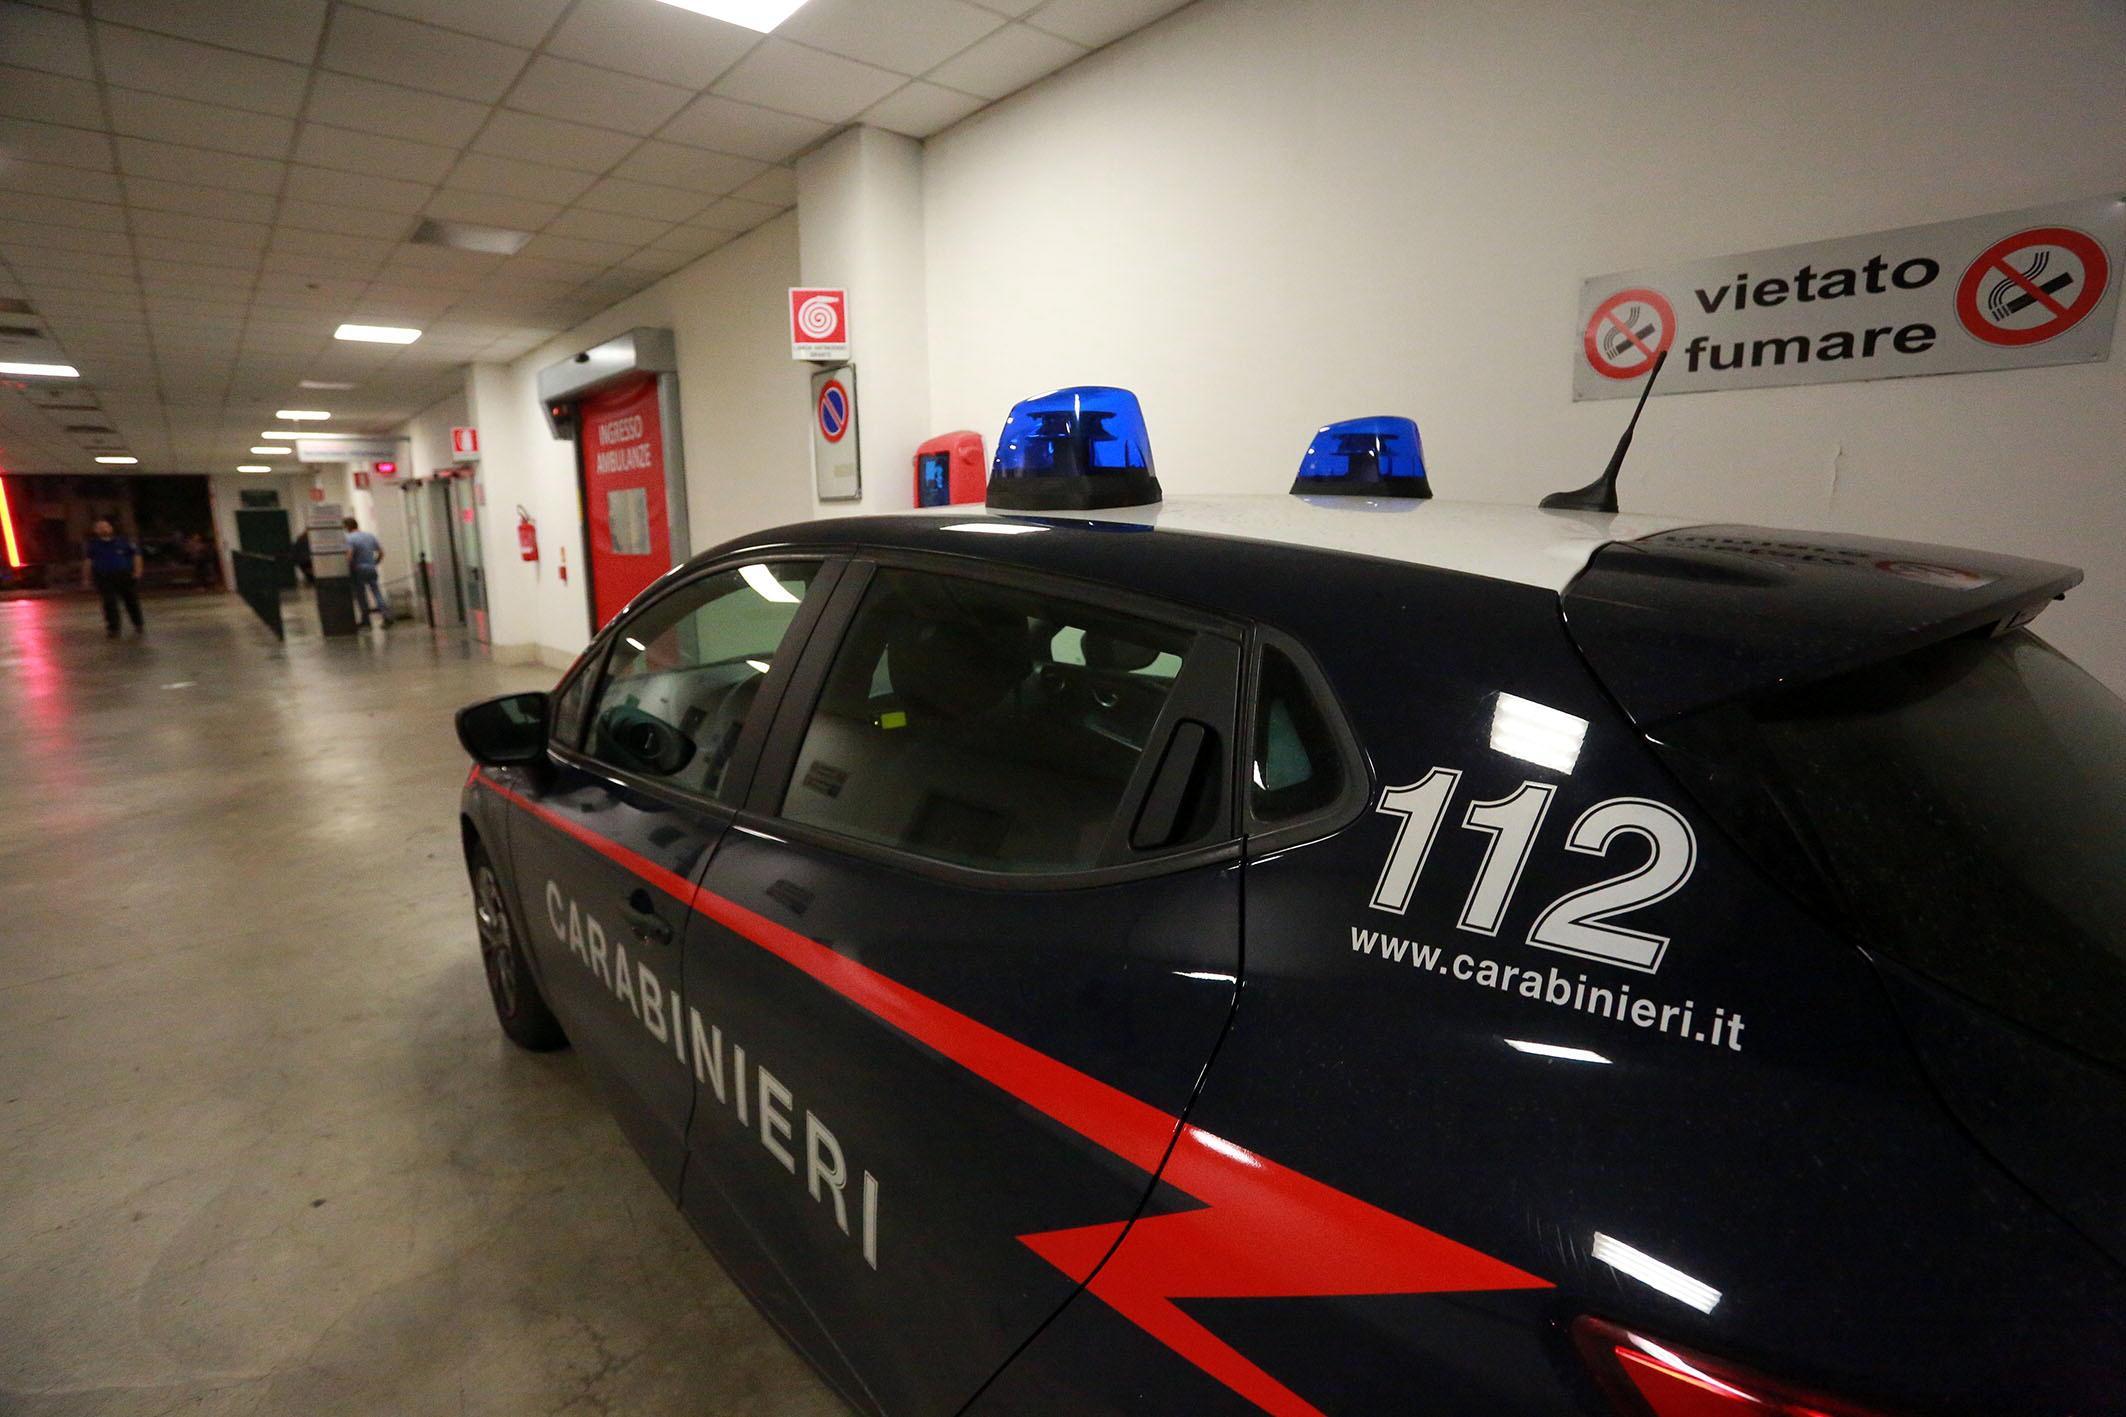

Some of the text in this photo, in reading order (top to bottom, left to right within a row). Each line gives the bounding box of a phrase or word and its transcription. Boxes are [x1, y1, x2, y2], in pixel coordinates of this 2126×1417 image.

[1695, 255, 1940, 314] vietato
[1686, 323, 1937, 372] fumare
[597, 444, 652, 474] AMBULANZE
[599, 416, 644, 445] INGRESSO
[1369, 766, 1698, 975] 112
[1351, 926, 1745, 1052] www.carabinieri.it
[546, 881, 878, 1270] CARABINIERI
